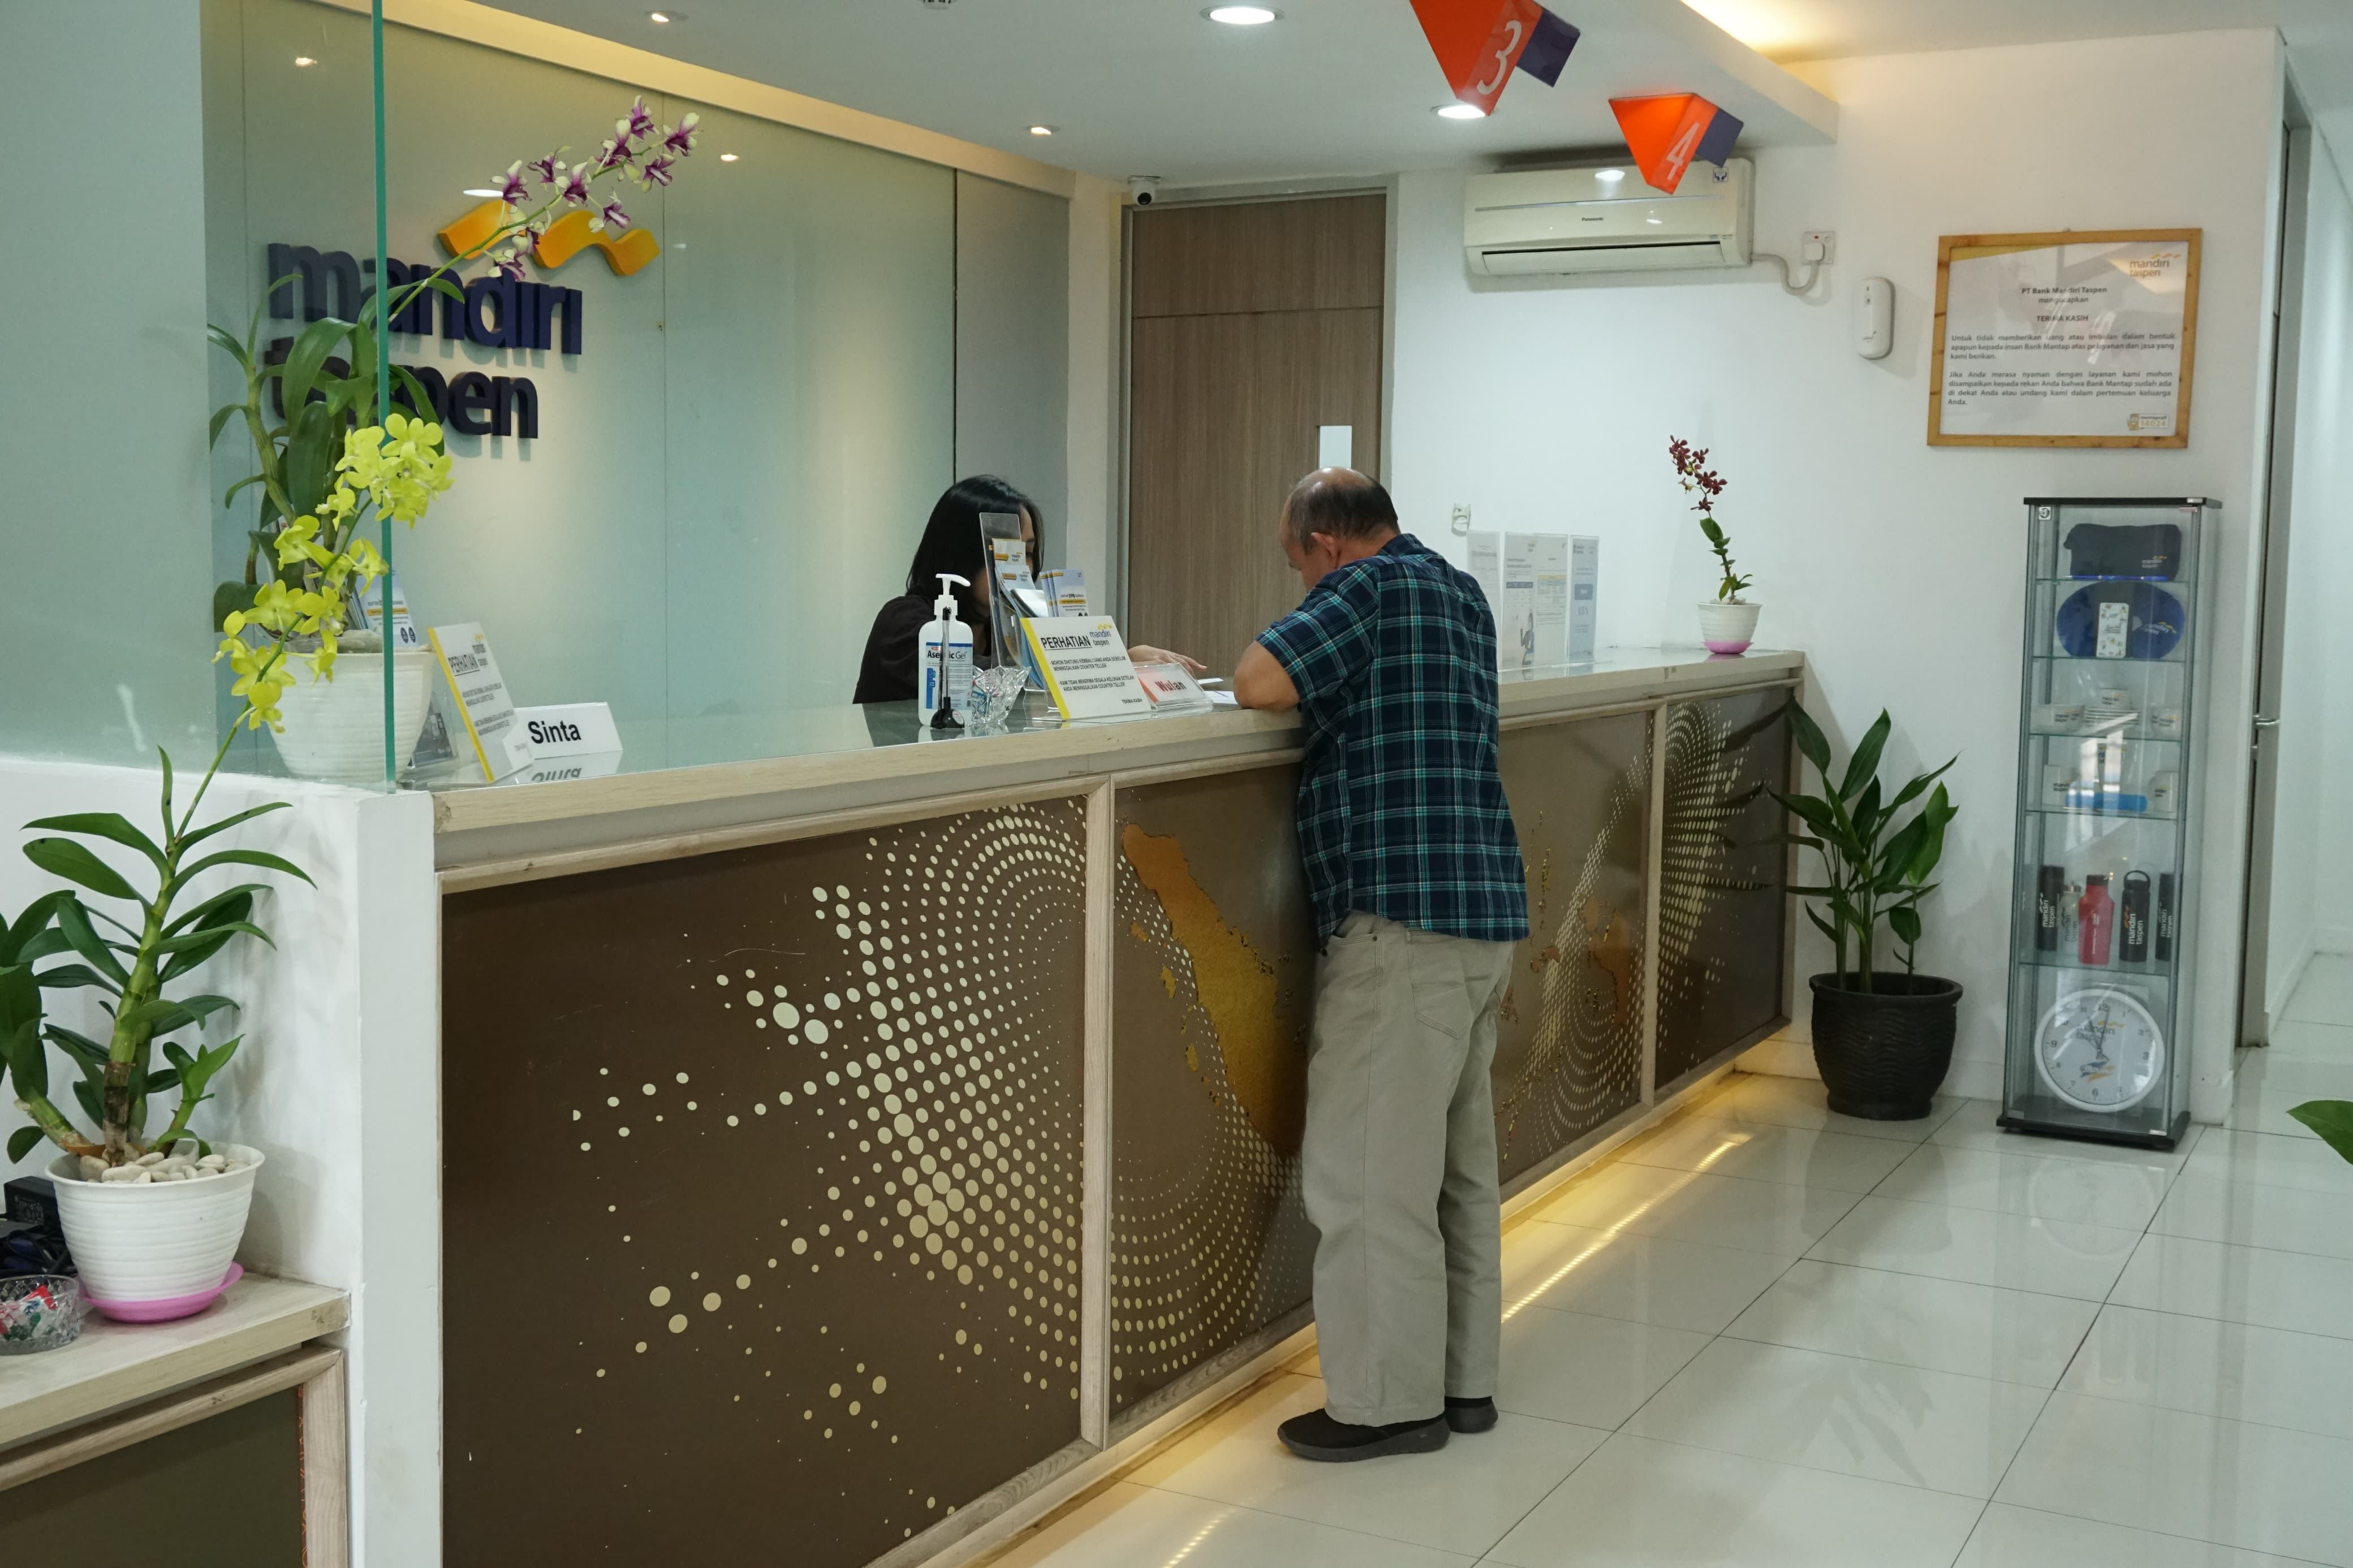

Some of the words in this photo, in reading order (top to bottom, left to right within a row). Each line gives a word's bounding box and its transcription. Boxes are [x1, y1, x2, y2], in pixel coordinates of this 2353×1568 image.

[1476, 20, 1522, 95] 3
[1666, 121, 1700, 180] 4
[2130, 258, 2169, 268] mandiri
[2130, 270, 2161, 279] taspen
[1040, 636, 1092, 649] PERHATIAN
[1089, 629, 1111, 638] mandiri
[927, 650, 954, 659] Aseic
[955, 651, 966, 659] Gel
[1155, 680, 1187, 692] Wulan
[528, 720, 581, 744] Sinta
